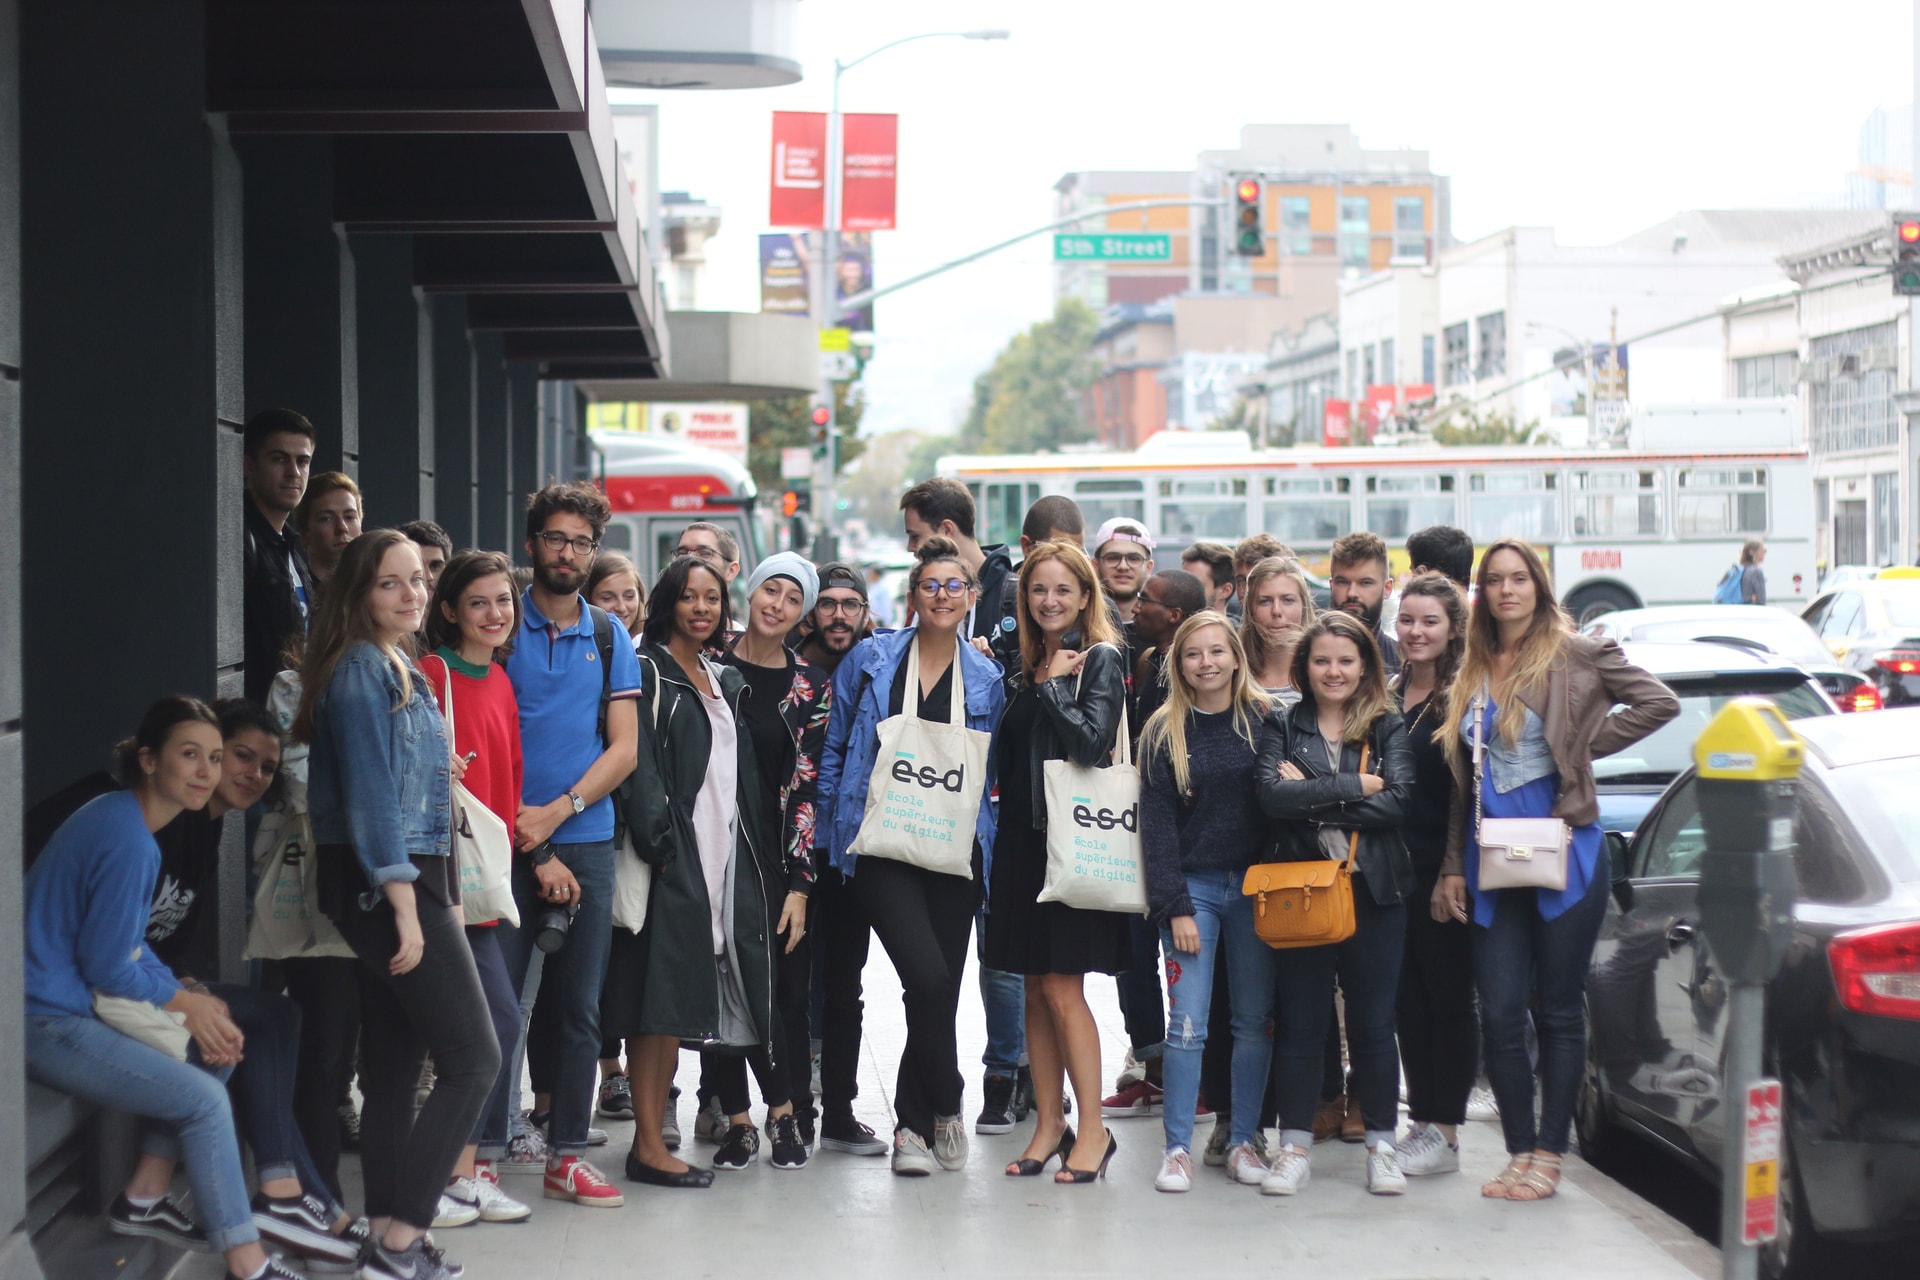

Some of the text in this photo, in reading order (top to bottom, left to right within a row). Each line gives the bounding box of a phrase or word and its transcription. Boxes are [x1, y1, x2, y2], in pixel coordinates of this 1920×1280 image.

[1101, 238, 1166, 256] Street
[882, 818, 953, 842] du digital
[1074, 864, 1137, 883] du digital
